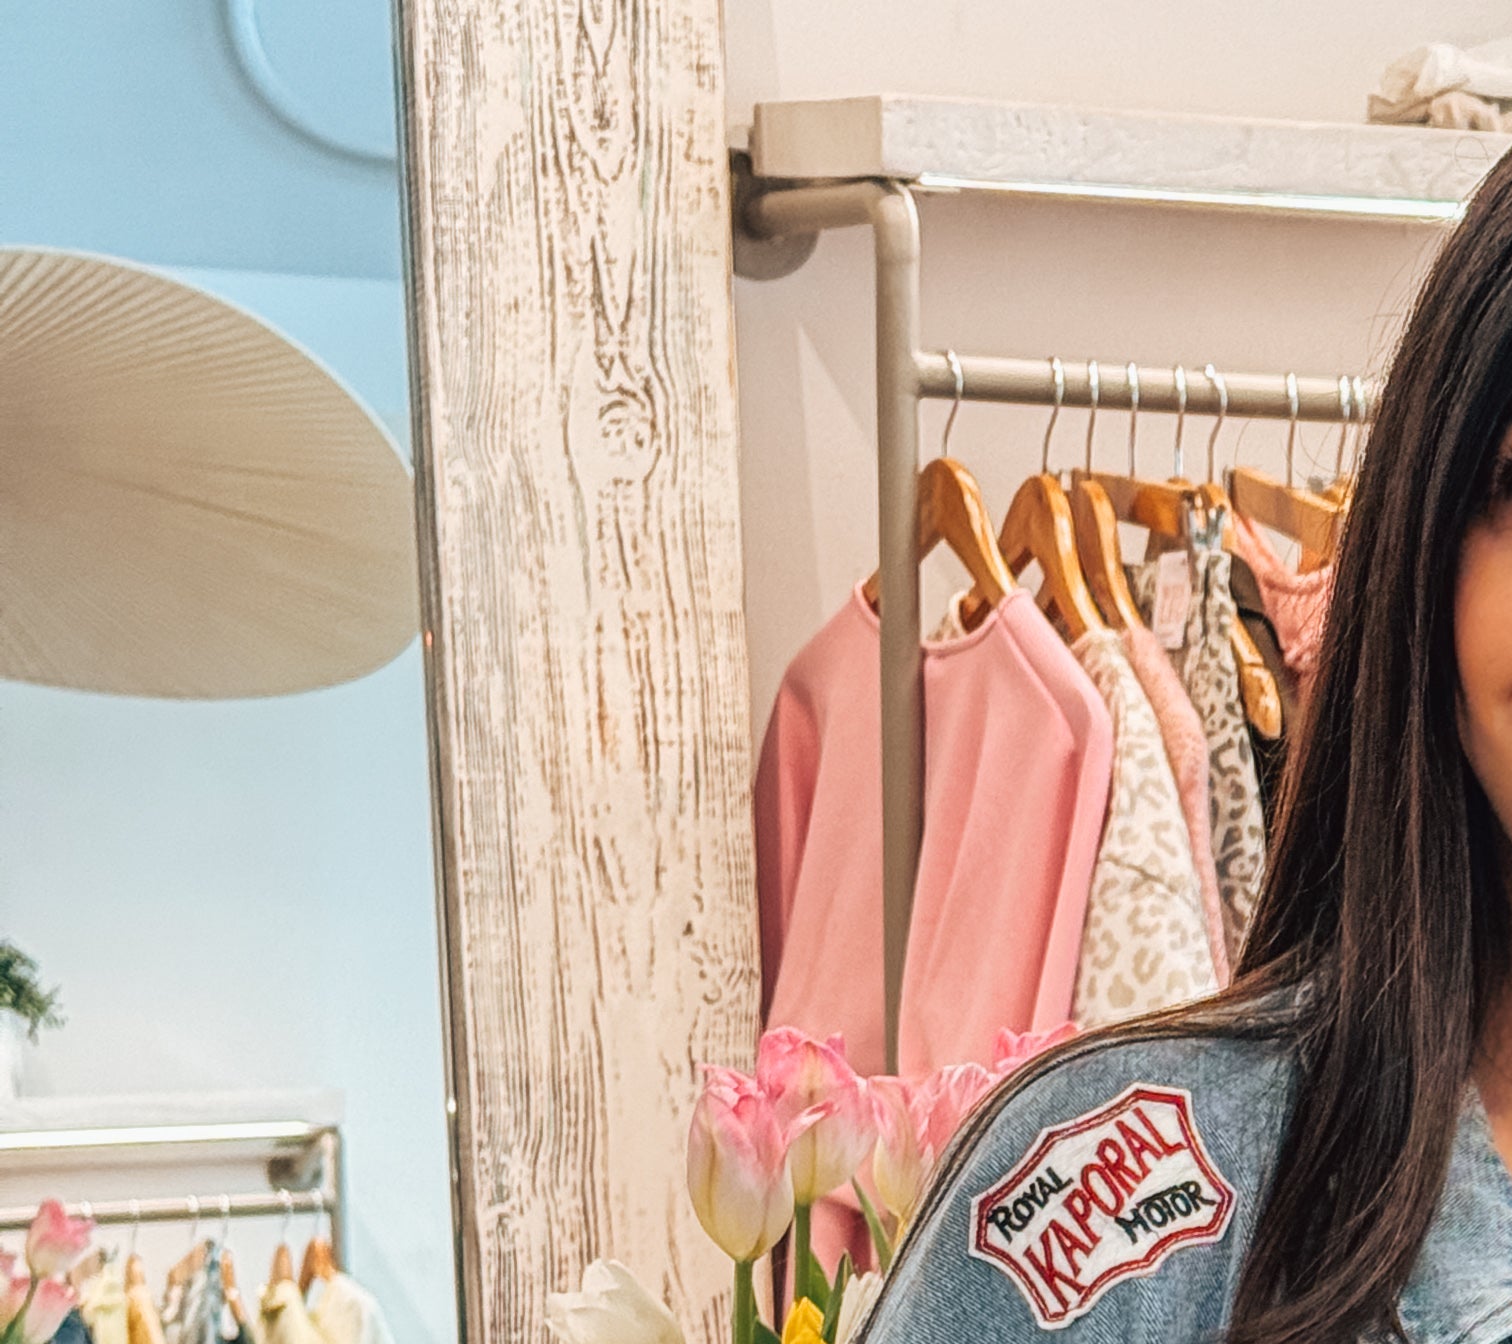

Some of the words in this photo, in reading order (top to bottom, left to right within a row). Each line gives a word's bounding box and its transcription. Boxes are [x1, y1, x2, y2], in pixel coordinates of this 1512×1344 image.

[988, 1167, 1073, 1244] ROYAL
[1024, 1107, 1187, 1313] KAPORAL
[1115, 1180, 1217, 1245] MOTOR
